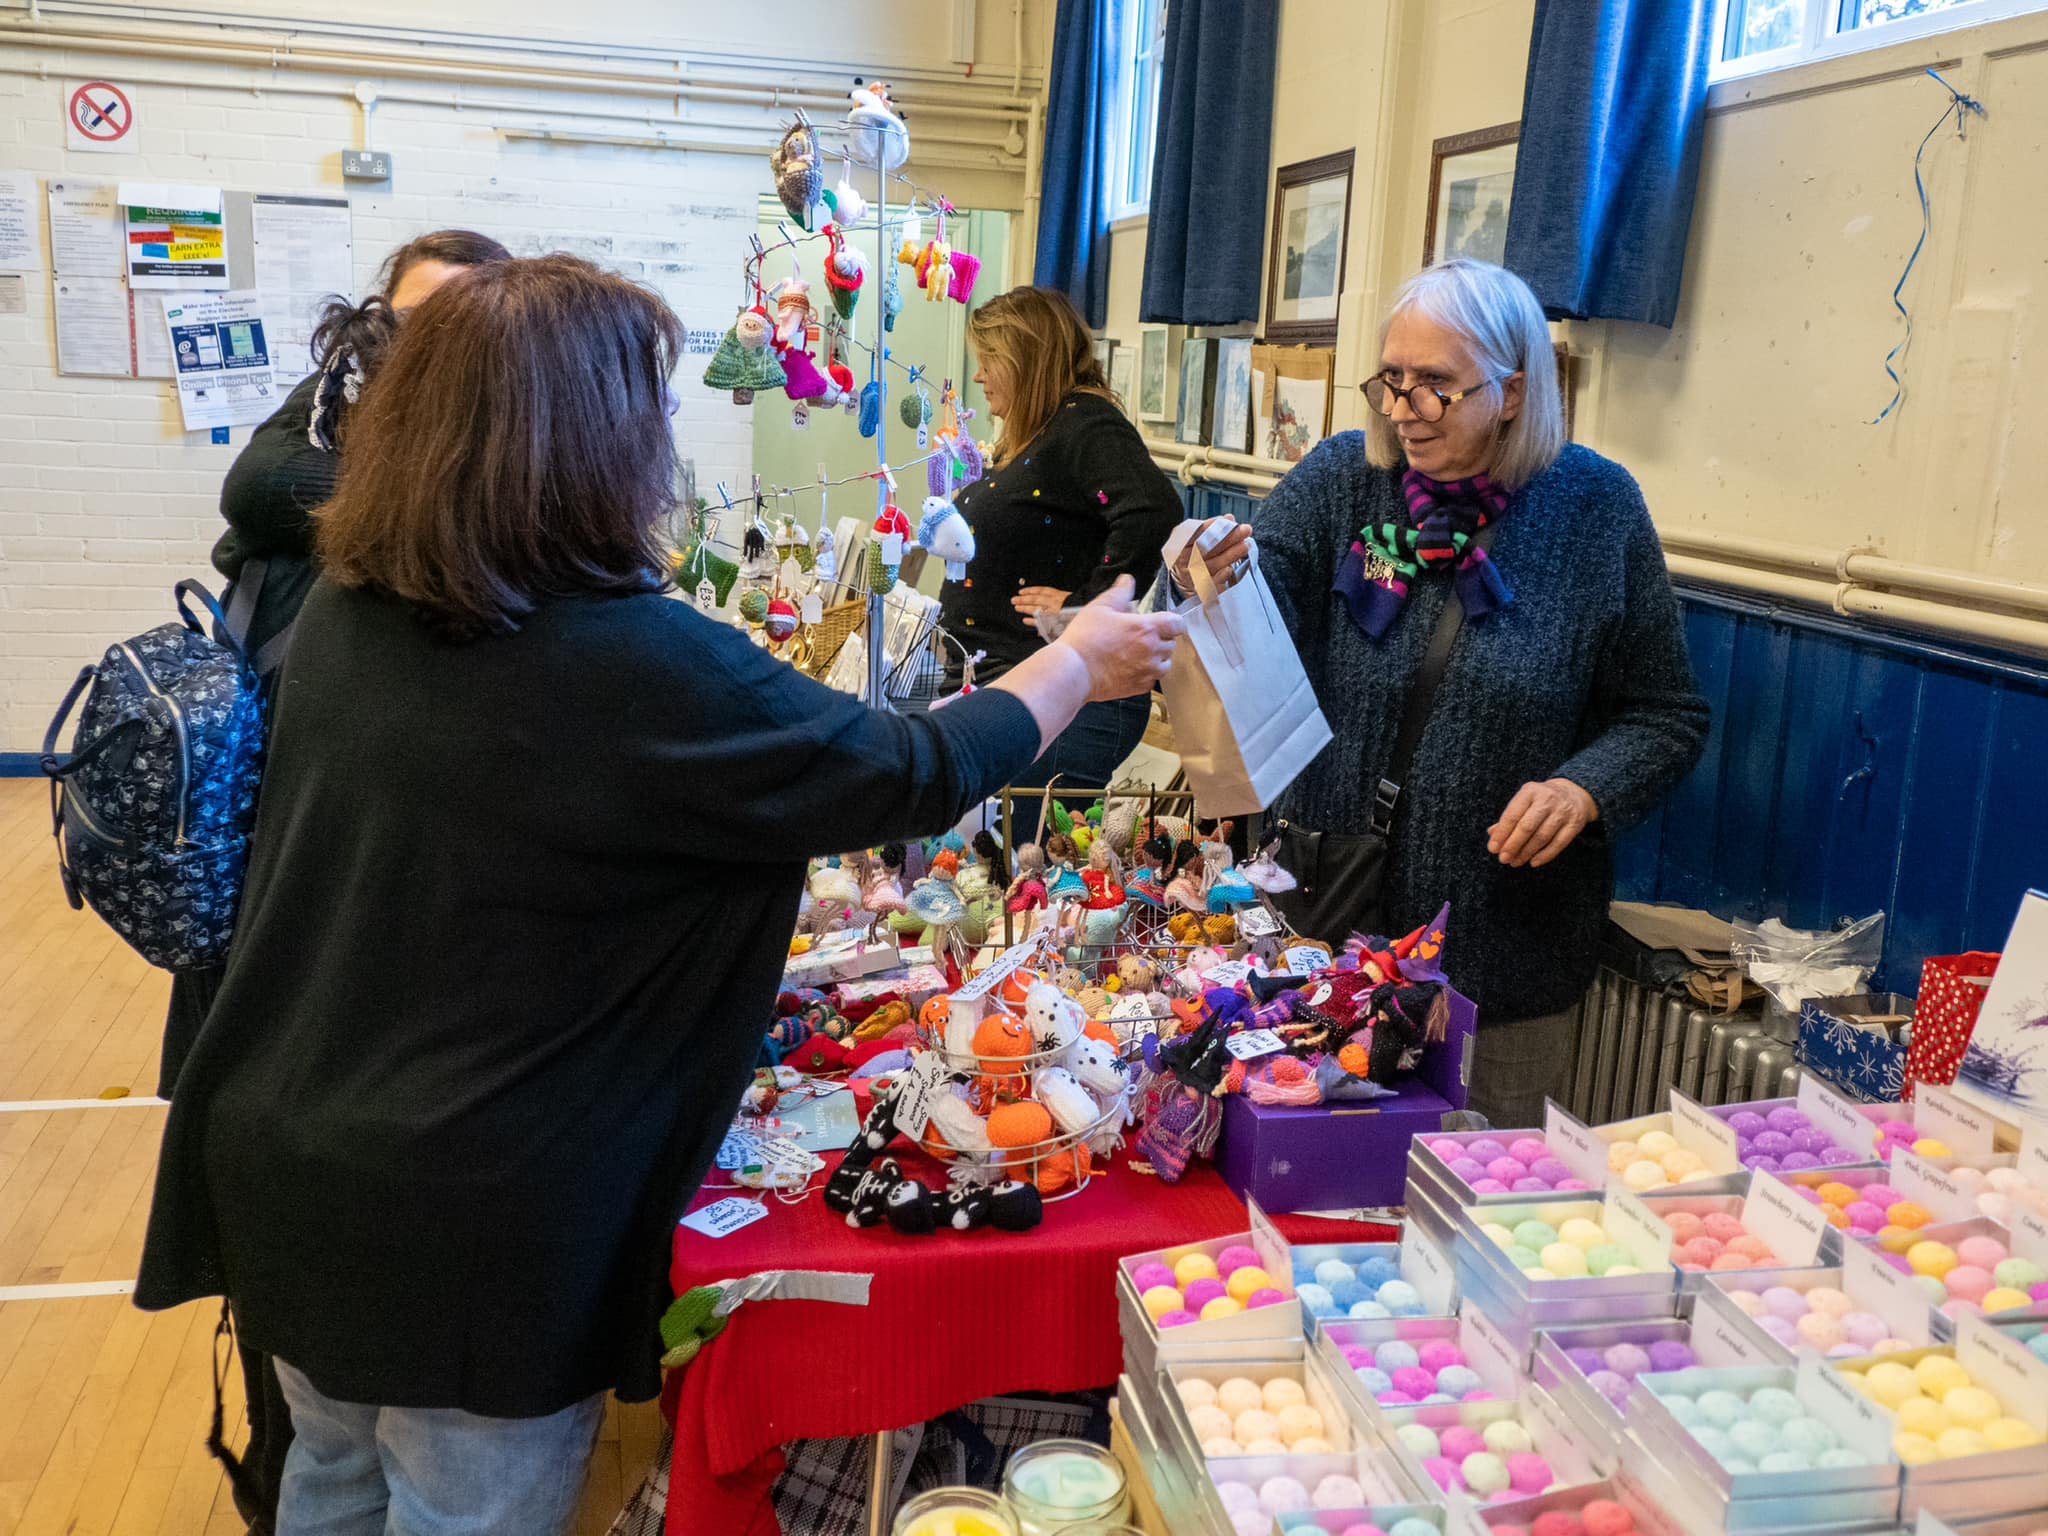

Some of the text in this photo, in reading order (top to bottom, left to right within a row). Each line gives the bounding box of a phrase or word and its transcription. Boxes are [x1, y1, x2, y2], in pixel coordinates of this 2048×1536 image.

[195, 242, 221, 250] EXTRA
[689, 330, 717, 338] ADIES
[182, 373, 271, 390] Online Phone Text
[795, 411, 807, 425] £3
